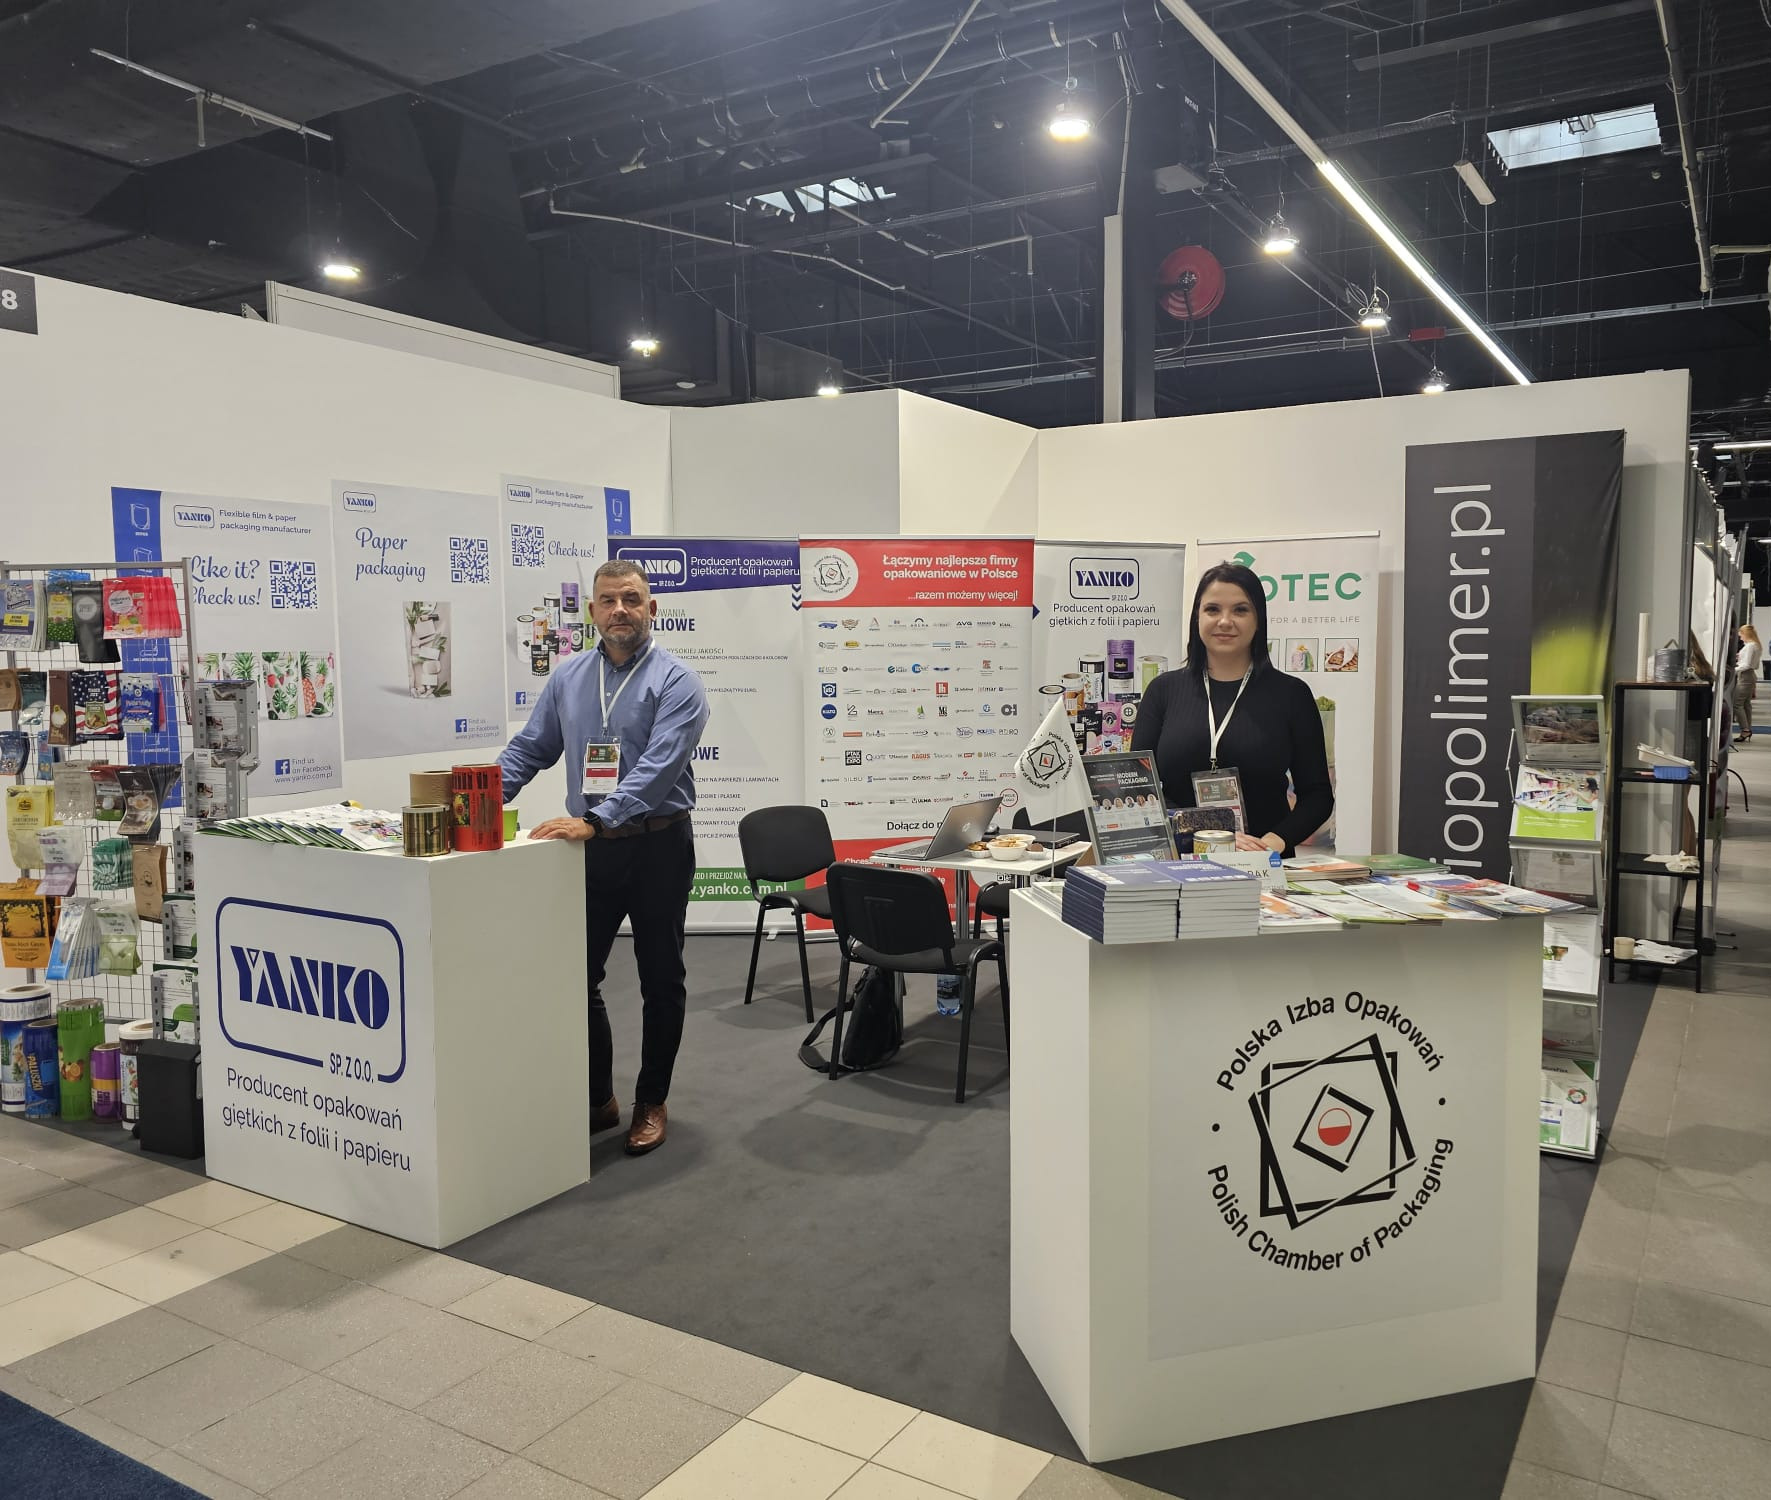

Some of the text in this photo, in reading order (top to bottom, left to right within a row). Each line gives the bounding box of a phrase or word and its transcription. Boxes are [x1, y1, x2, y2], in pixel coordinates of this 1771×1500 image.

[346, 497, 374, 508] YANKO
[177, 511, 212, 523] YANKO
[219, 509, 251, 519] Flexible
[252, 511, 267, 520] film
[275, 514, 297, 522] paper
[220, 522, 312, 535] packaging manufacturer
[355, 527, 408, 557] Paper
[548, 540, 596, 558] Check us!
[690, 556, 793, 570] Producent opakowań
[882, 555, 1018, 568] Łączymy najlepsze firmy
[191, 555, 260, 583] Like it?
[355, 557, 426, 583] packaging
[690, 566, 730, 578] giętkich
[739, 567, 756, 576] folii
[758, 567, 761, 575] i
[764, 568, 800, 578] papieru
[883, 567, 1018, 580] opakowaniowe w Polsce
[1075, 570, 1135, 587] YANKO
[238, 587, 262, 606] us!
[946, 590, 986, 602] możemy
[987, 590, 1018, 602] więcej!
[1053, 603, 1156, 614] Producent opakowań
[1049, 616, 1160, 628] giętkich z folii i papieru
[1270, 616, 1285, 624] FOR
[1301, 616, 1337, 624] BETTER
[1340, 615, 1360, 624] LIFE
[1429, 484, 1505, 868] iopolimer.pl
[302, 764, 333, 773] Facebook
[1117, 776, 1149, 785] PACKAGING
[887, 821, 934, 832] Dołącz do
[230, 945, 390, 1030] YANKO
[1216, 991, 1444, 1092] Polska Izba Opakowań
[330, 1052, 375, 1084] SP. Z O.O.
[227, 1067, 402, 1131] Producent opakowań
[222, 1104, 411, 1173] giętkich z folii i papieru
[1208, 1138, 1454, 1271] Polish Chamber of Packaging
